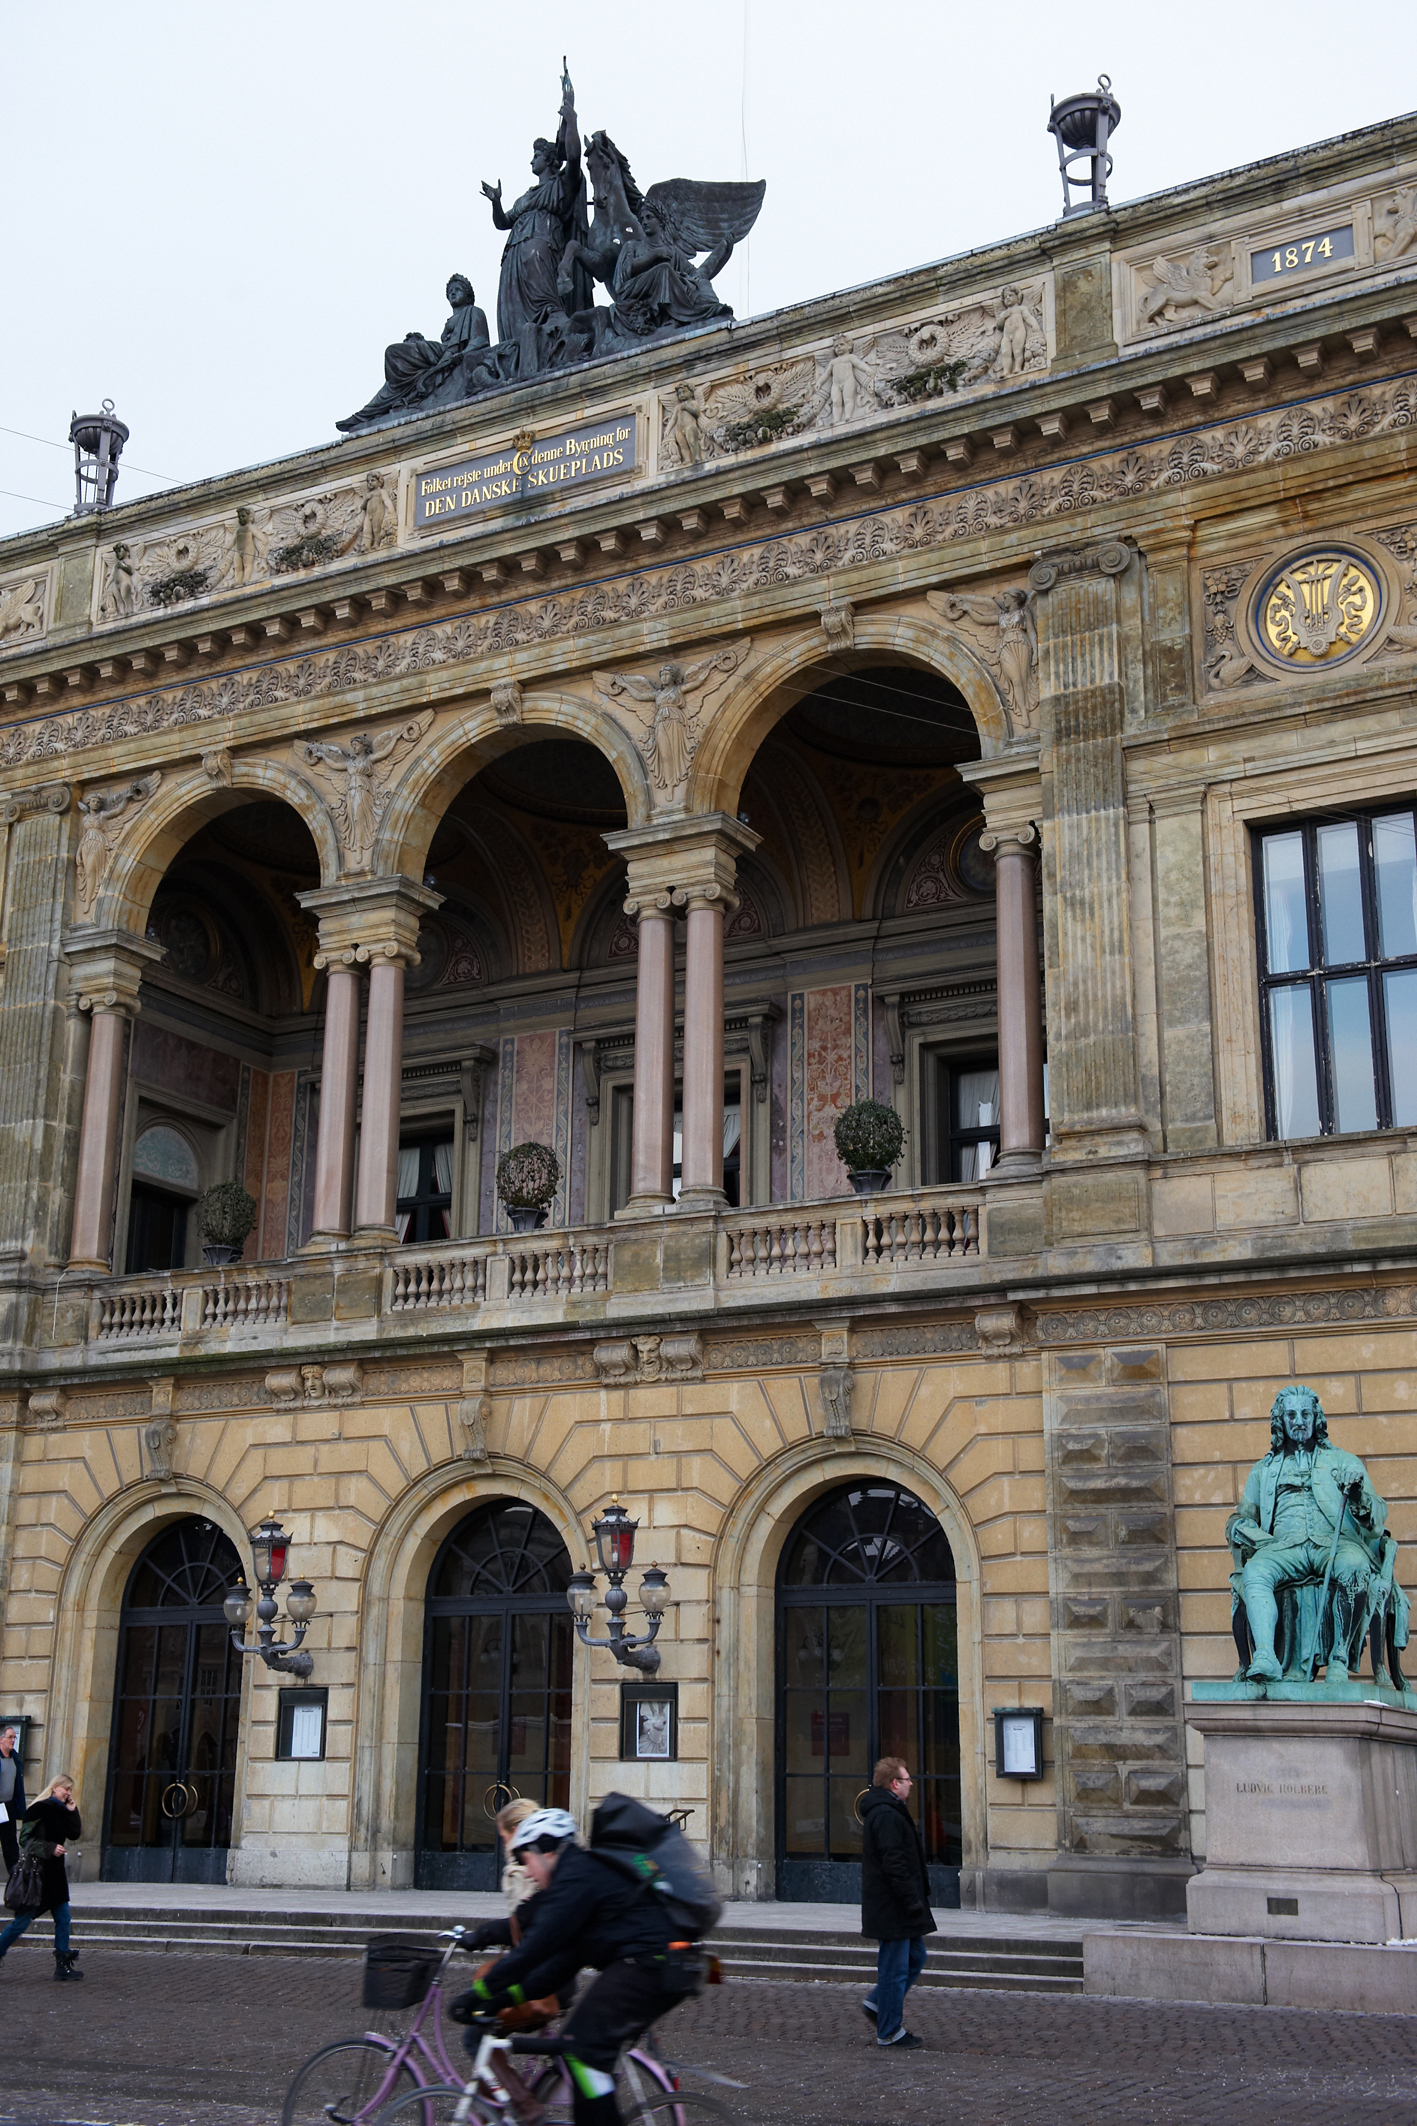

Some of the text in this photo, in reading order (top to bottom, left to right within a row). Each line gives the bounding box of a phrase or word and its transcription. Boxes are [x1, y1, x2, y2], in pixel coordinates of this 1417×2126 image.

[1271, 236, 1334, 273] 1874
[421, 476, 452, 497] Folket
[453, 469, 481, 489] rejste
[483, 459, 513, 479] under
[531, 449, 564, 465] denne
[565, 432, 615, 457] Bygning
[616, 426, 631, 442] for
[425, 448, 624, 518] DEN DANSKE SKUEPLADS
